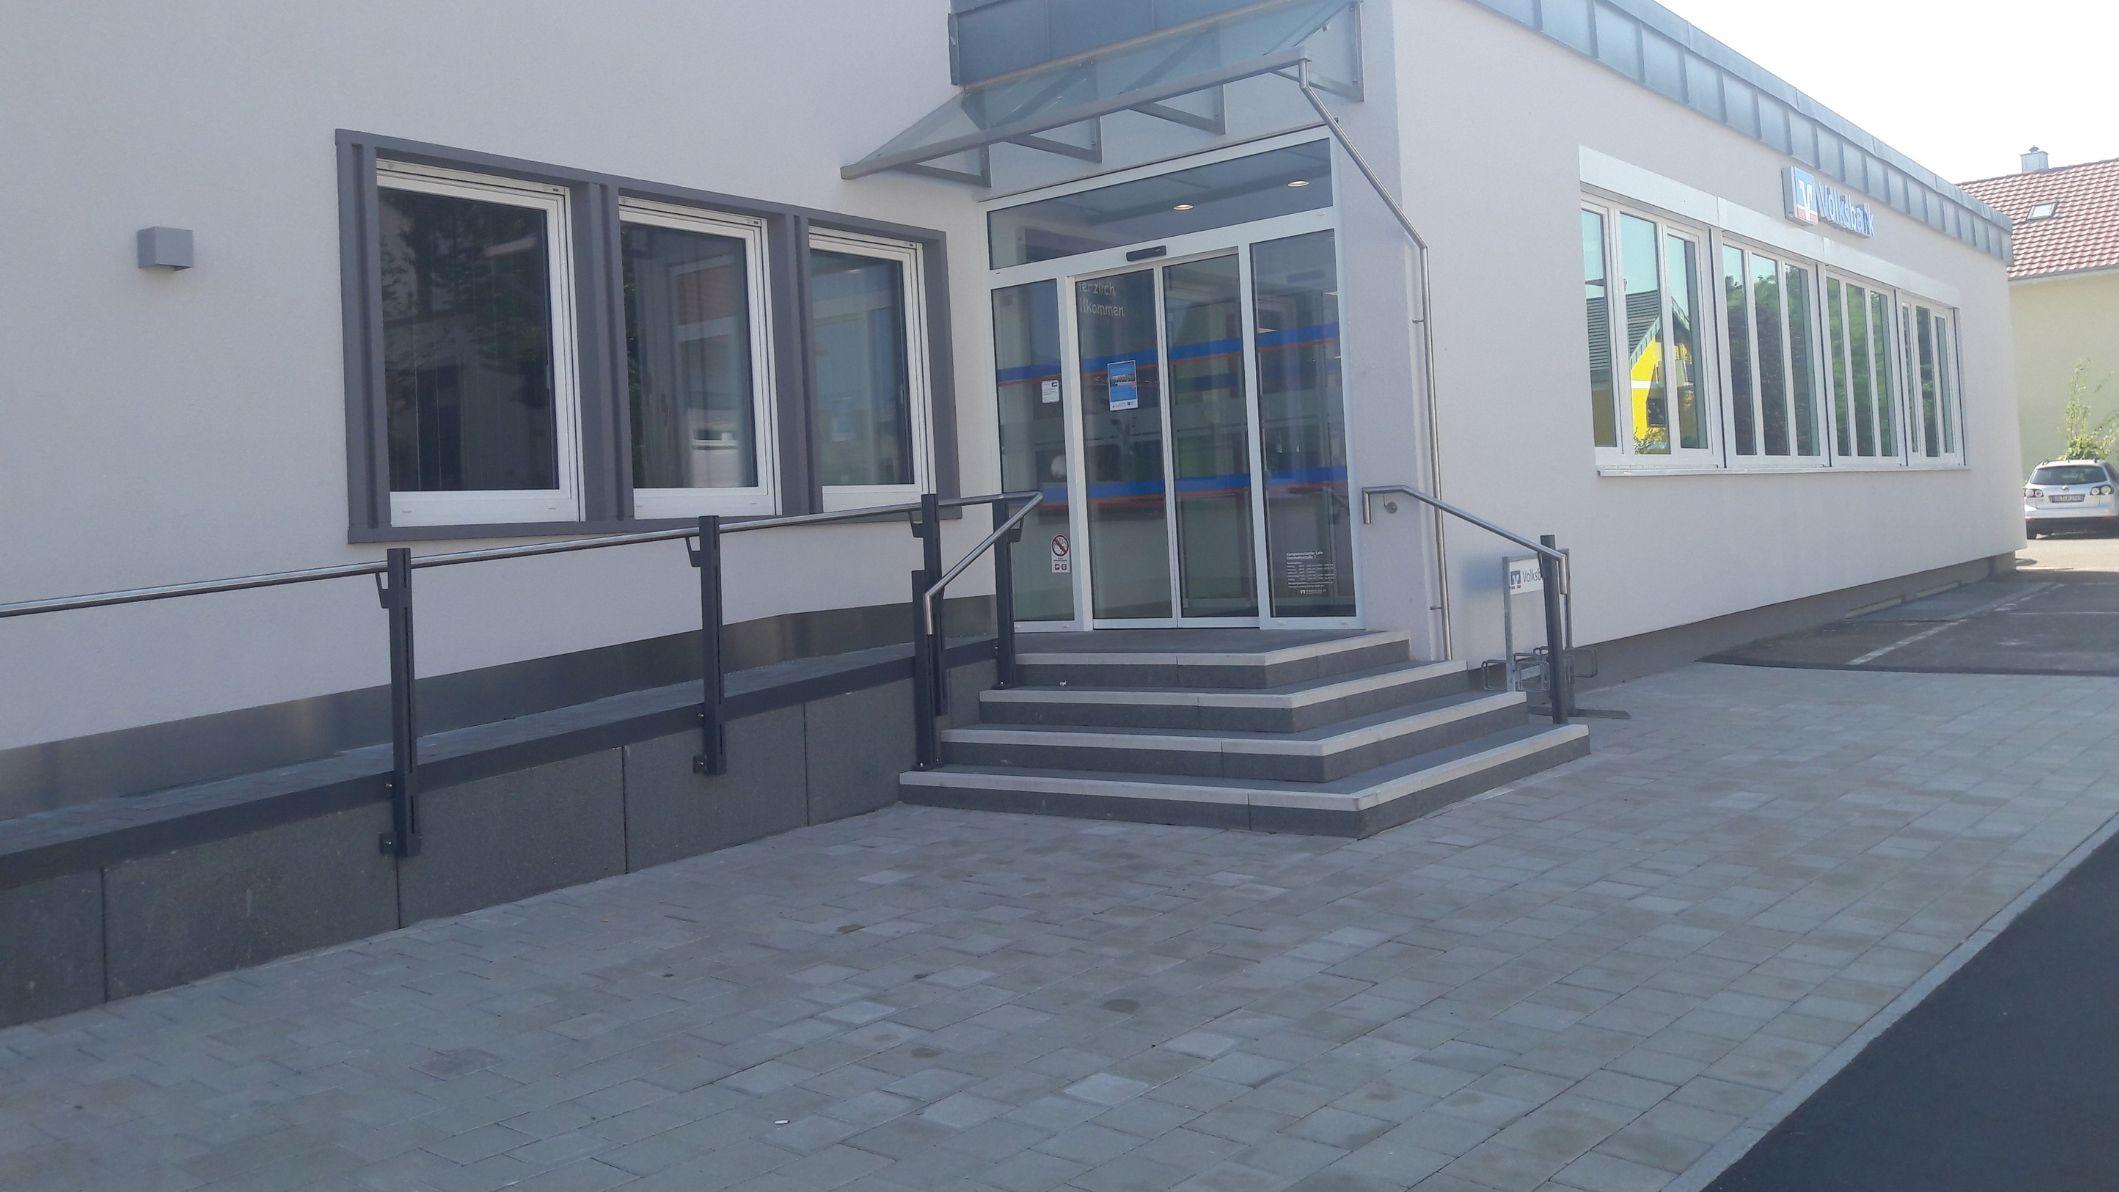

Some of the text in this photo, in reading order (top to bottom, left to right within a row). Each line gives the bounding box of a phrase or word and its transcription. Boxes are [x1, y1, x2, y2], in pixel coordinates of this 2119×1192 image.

[1815, 182, 1875, 237] Volksbank
[1080, 299, 1124, 317] llkommen
[1522, 568, 1542, 582] Volksb
